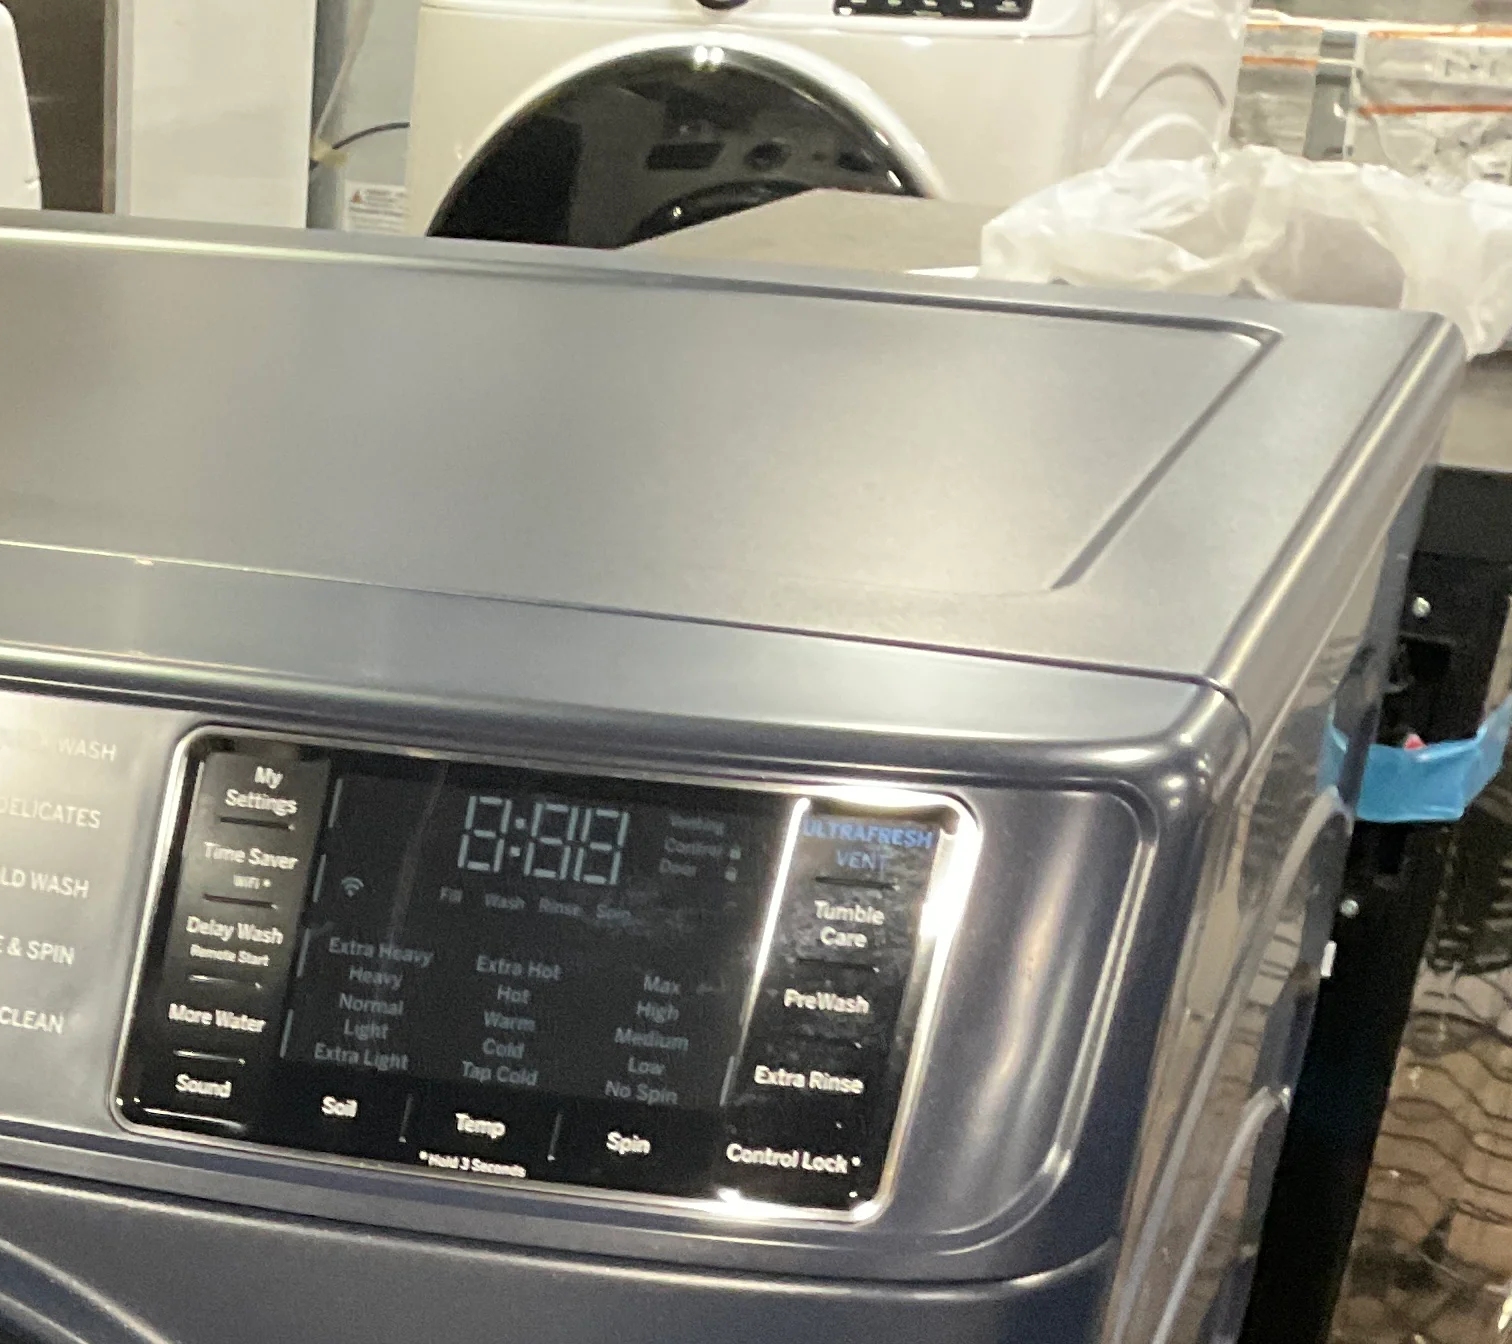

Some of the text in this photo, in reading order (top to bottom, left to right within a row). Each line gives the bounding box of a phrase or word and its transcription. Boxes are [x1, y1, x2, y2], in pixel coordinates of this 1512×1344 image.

[57, 737, 117, 762] WASH
[255, 766, 283, 789] My
[225, 788, 298, 816] Settings
[803, 817, 934, 850] ULTRAFRESH
[204, 842, 298, 870] Time Saver
[30, 869, 89, 898] WASH
[814, 900, 885, 925] Tumble
[186, 915, 283, 945] Delay Wash
[819, 925, 868, 948] Care
[7, 937, 22, 957] &
[26, 940, 75, 965] SPIN
[328, 936, 434, 968] Extra Heavy
[349, 965, 403, 991] Heavy
[476, 955, 562, 981] Extra Hot
[497, 984, 531, 1004] Hot
[643, 974, 680, 995] Max
[339, 992, 404, 1015] Normal
[637, 1000, 679, 1023] High
[784, 988, 870, 1014] PreWash
[168, 1003, 266, 1033] More Water
[343, 1018, 388, 1040] Light
[484, 1010, 535, 1032] Warm
[482, 1037, 525, 1059] Cold
[614, 1027, 689, 1050] Medium
[314, 1042, 409, 1071] Extra Light
[628, 1056, 665, 1075] Low
[462, 1059, 538, 1086] Tap Cold
[754, 1064, 864, 1094] Extra Rinse
[175, 1073, 232, 1098] Sound
[604, 1080, 678, 1105] No Spin
[321, 1096, 358, 1118] Soil
[455, 1113, 506, 1139] Temp
[606, 1131, 651, 1156] Spin
[726, 1143, 799, 1168] Control
[459, 1156, 470, 1171] 3
[471, 1157, 527, 1178] Seconds
